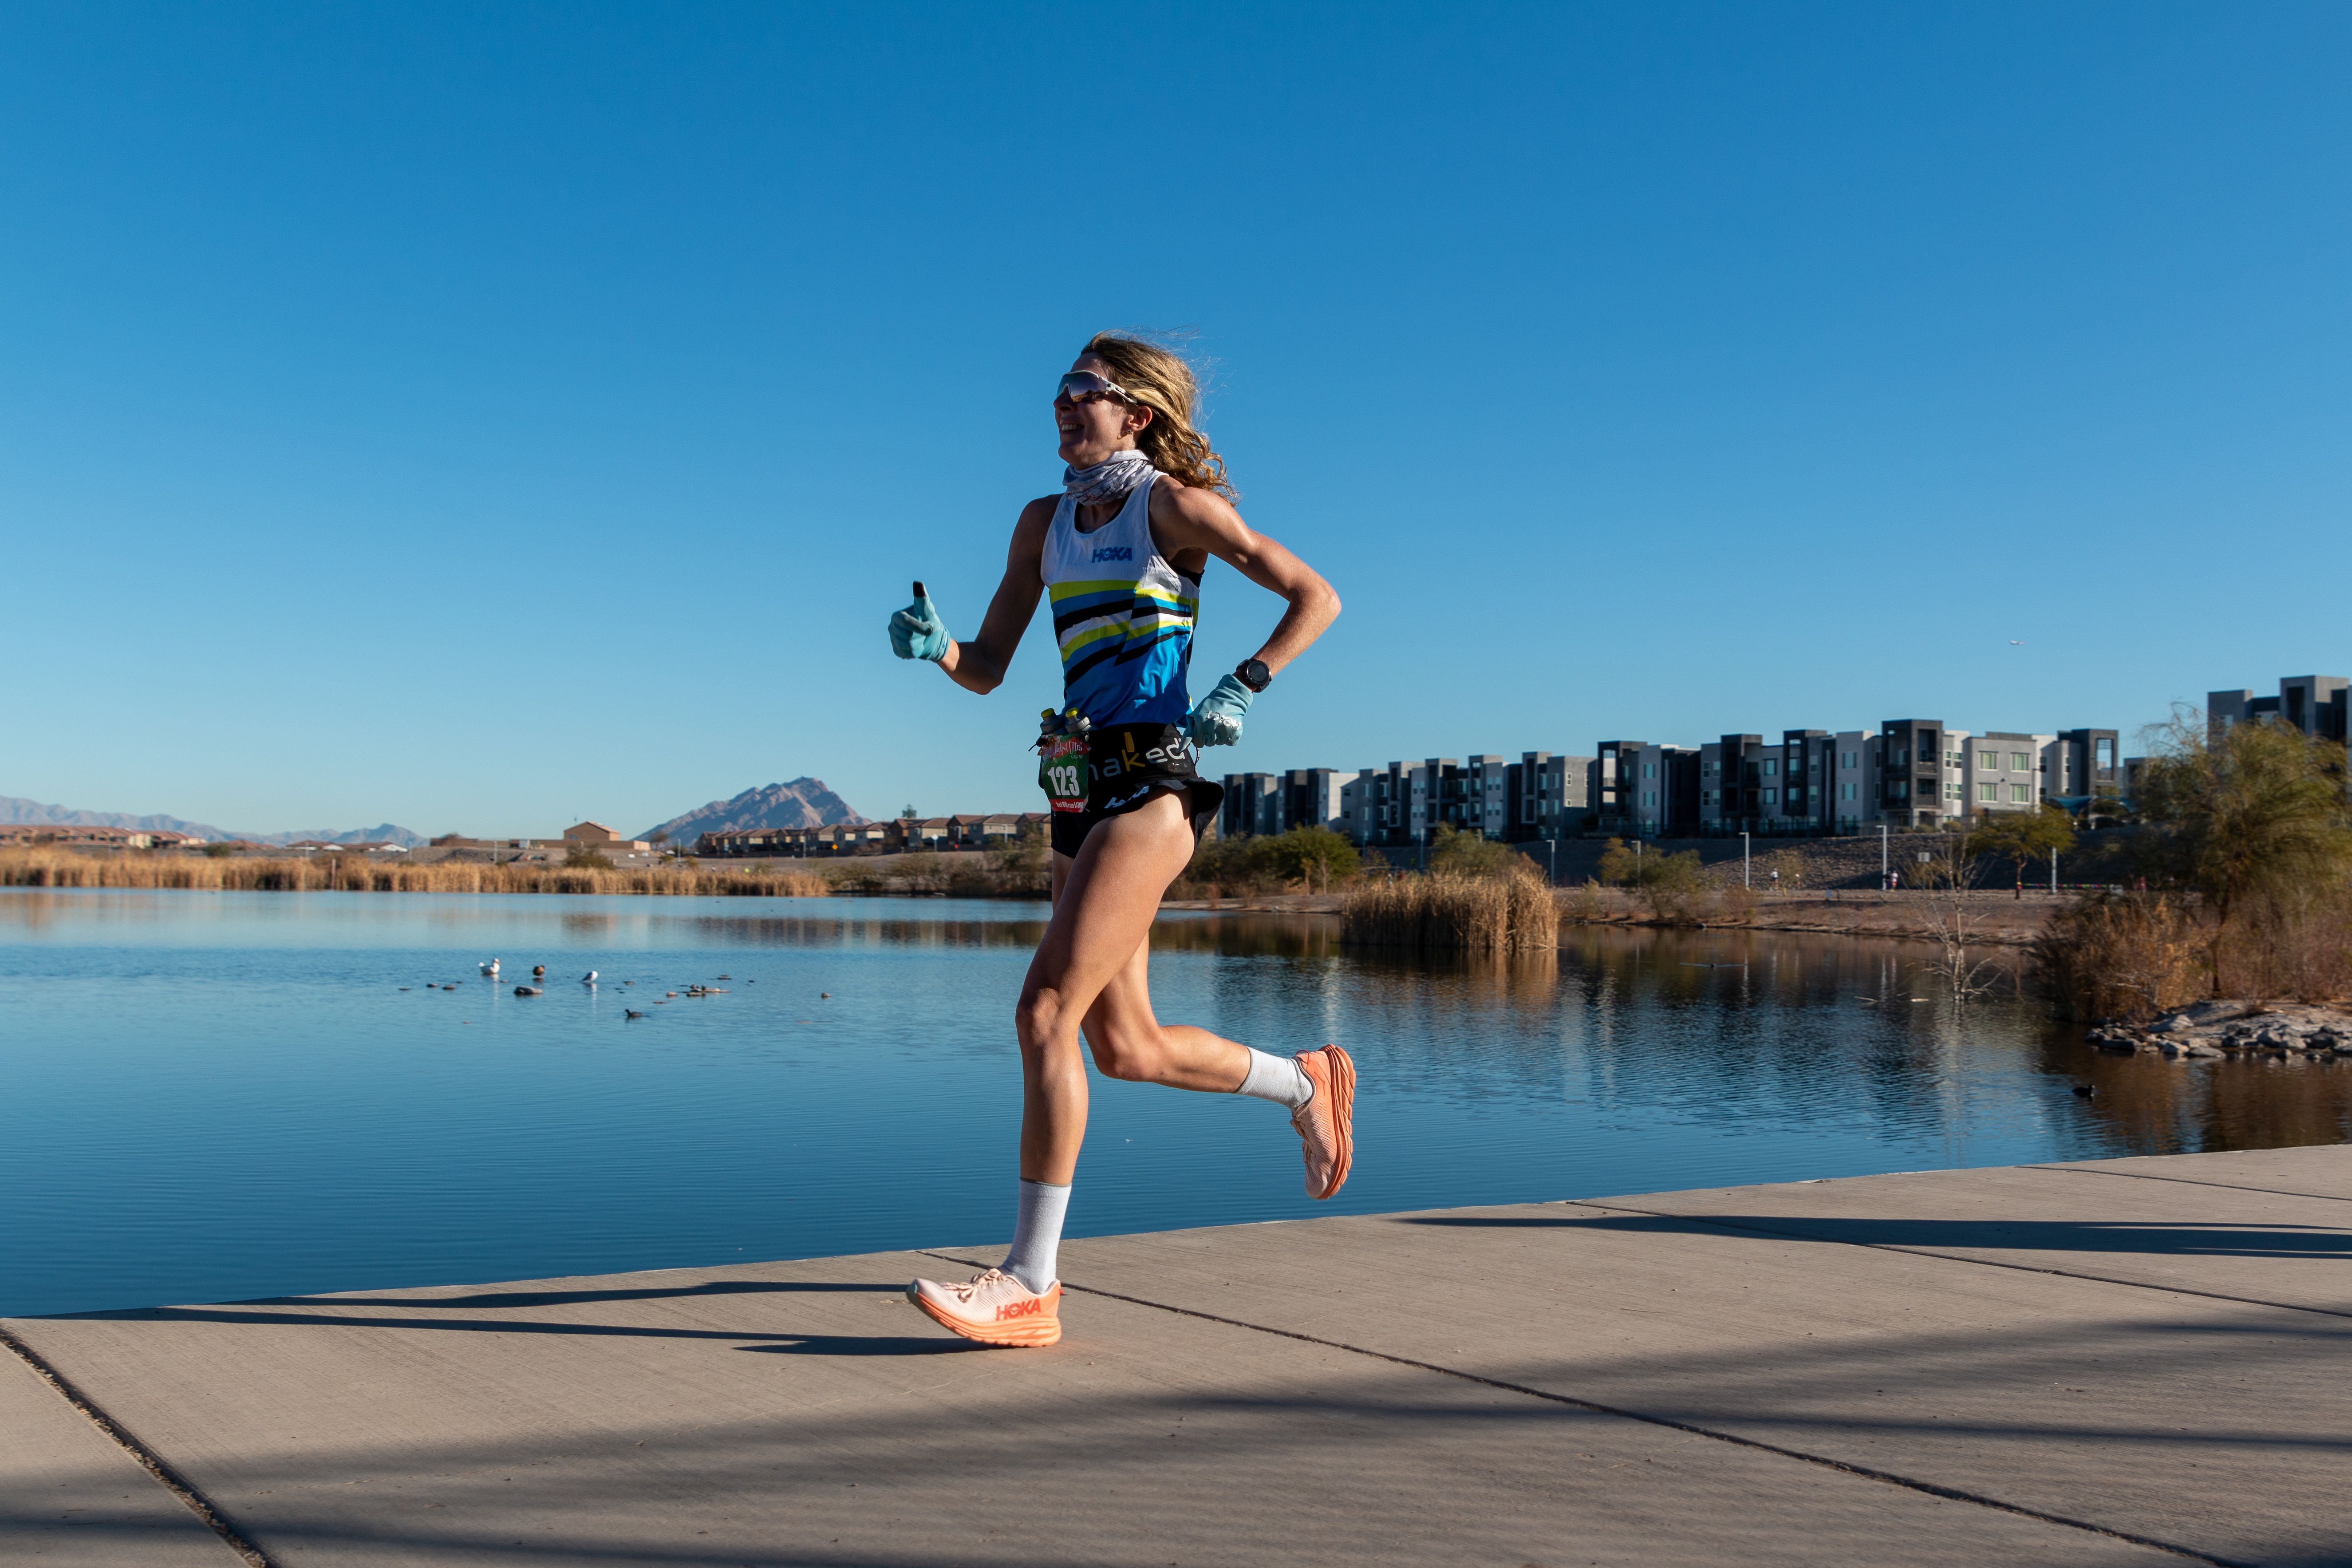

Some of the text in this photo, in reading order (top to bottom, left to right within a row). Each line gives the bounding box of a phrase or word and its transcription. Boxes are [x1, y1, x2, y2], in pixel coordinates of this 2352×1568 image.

[1091, 547, 1132, 563] HOKA
[1069, 741, 1083, 754] Ultra
[1047, 766, 1080, 796] 123
[995, 1298, 1041, 1321] HOKA
